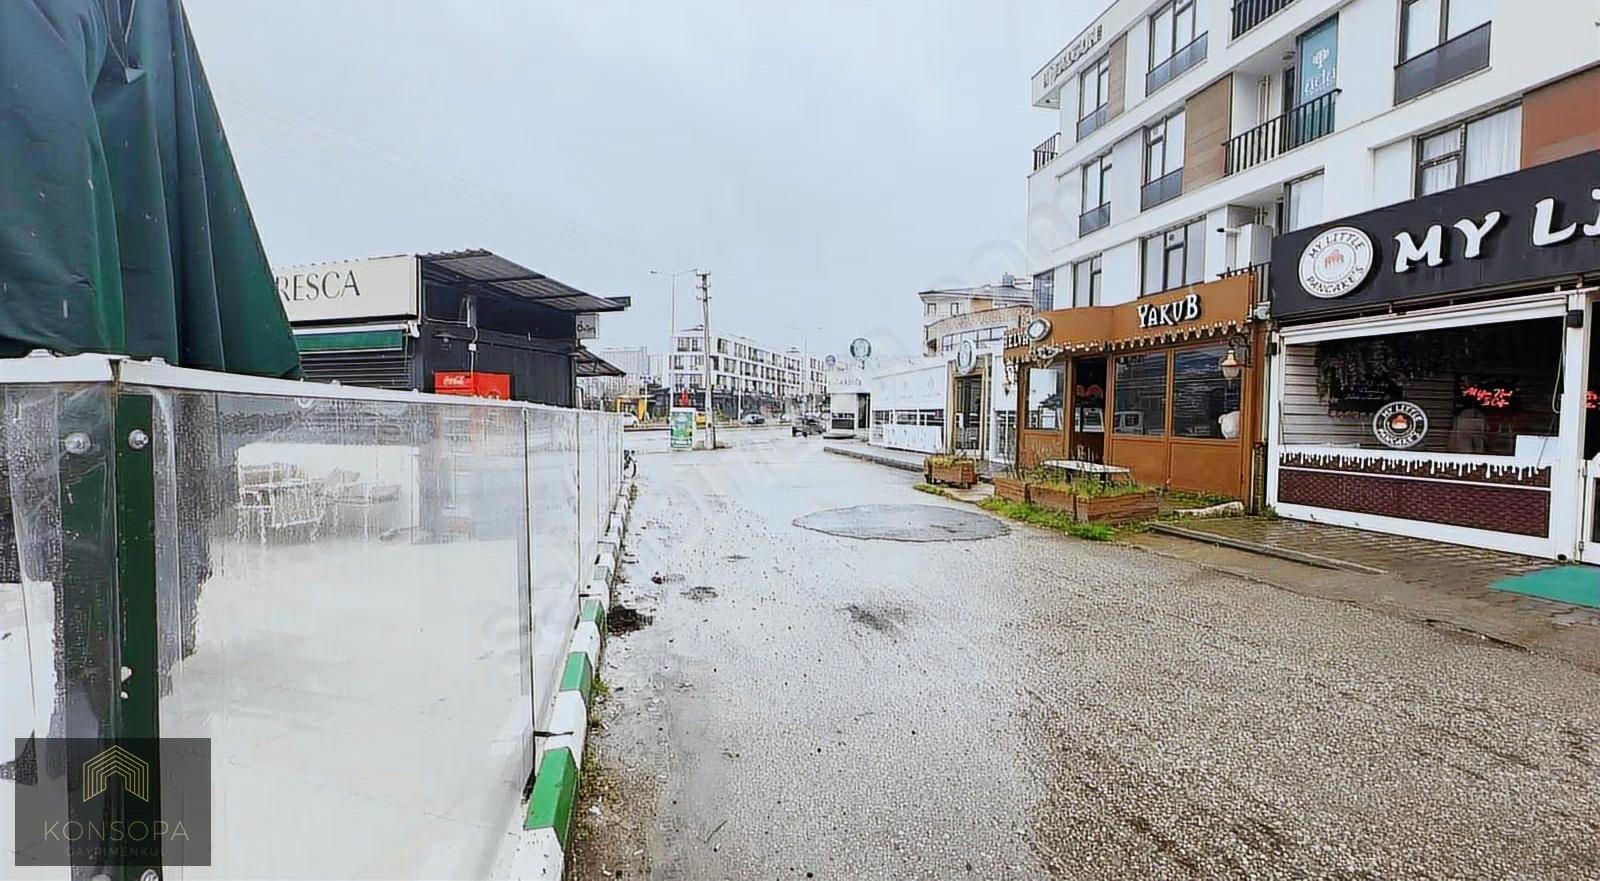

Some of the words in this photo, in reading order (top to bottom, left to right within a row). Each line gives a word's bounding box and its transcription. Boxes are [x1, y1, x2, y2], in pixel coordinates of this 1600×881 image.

[1326, 232, 1366, 250] LITTLE
[1394, 210, 1501, 274] MY
[1137, 293, 1200, 328] YAKUB
